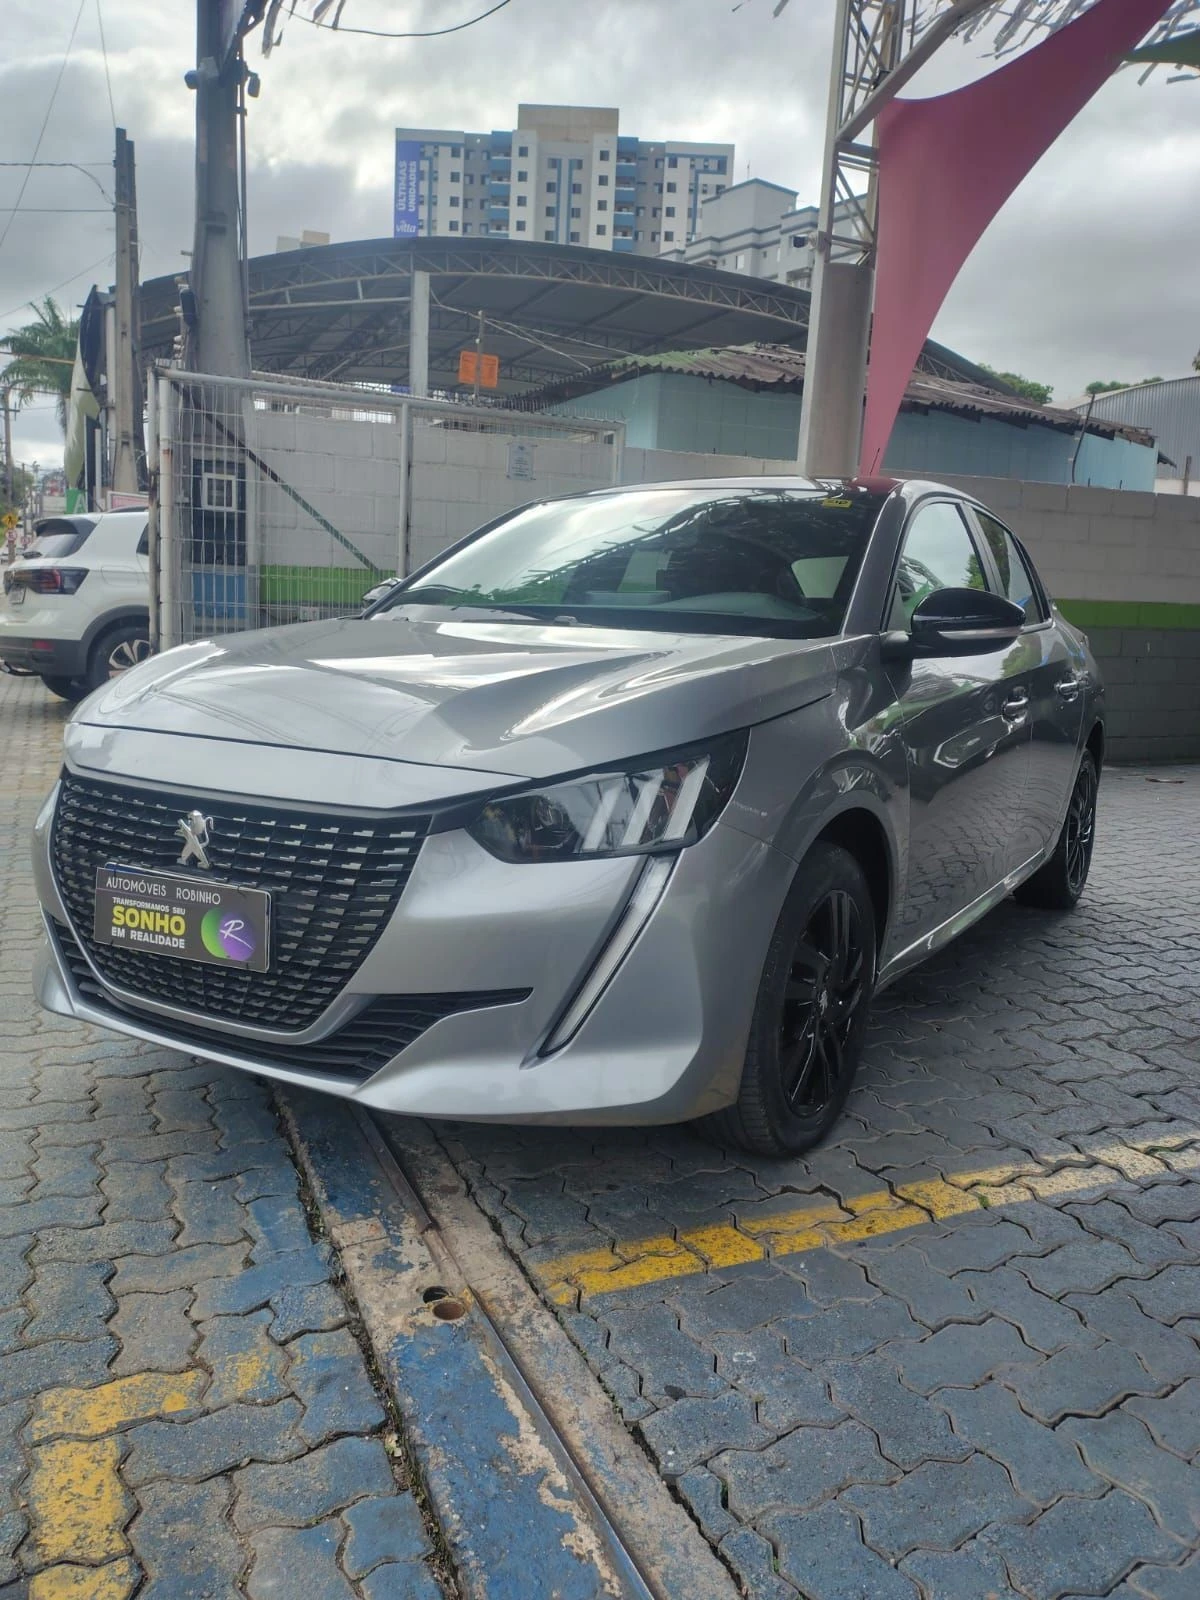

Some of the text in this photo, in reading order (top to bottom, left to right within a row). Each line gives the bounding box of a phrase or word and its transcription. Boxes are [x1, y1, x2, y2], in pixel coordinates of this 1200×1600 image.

[408, 160, 417, 212] UNIDADES
[106, 876, 221, 905] AUTOMÓVEIS ROBINHO
[112, 896, 186, 915] TRANSFORMAMOS SEU
[111, 905, 186, 936] SONHO
[111, 927, 185, 949] EM REALIDADE
